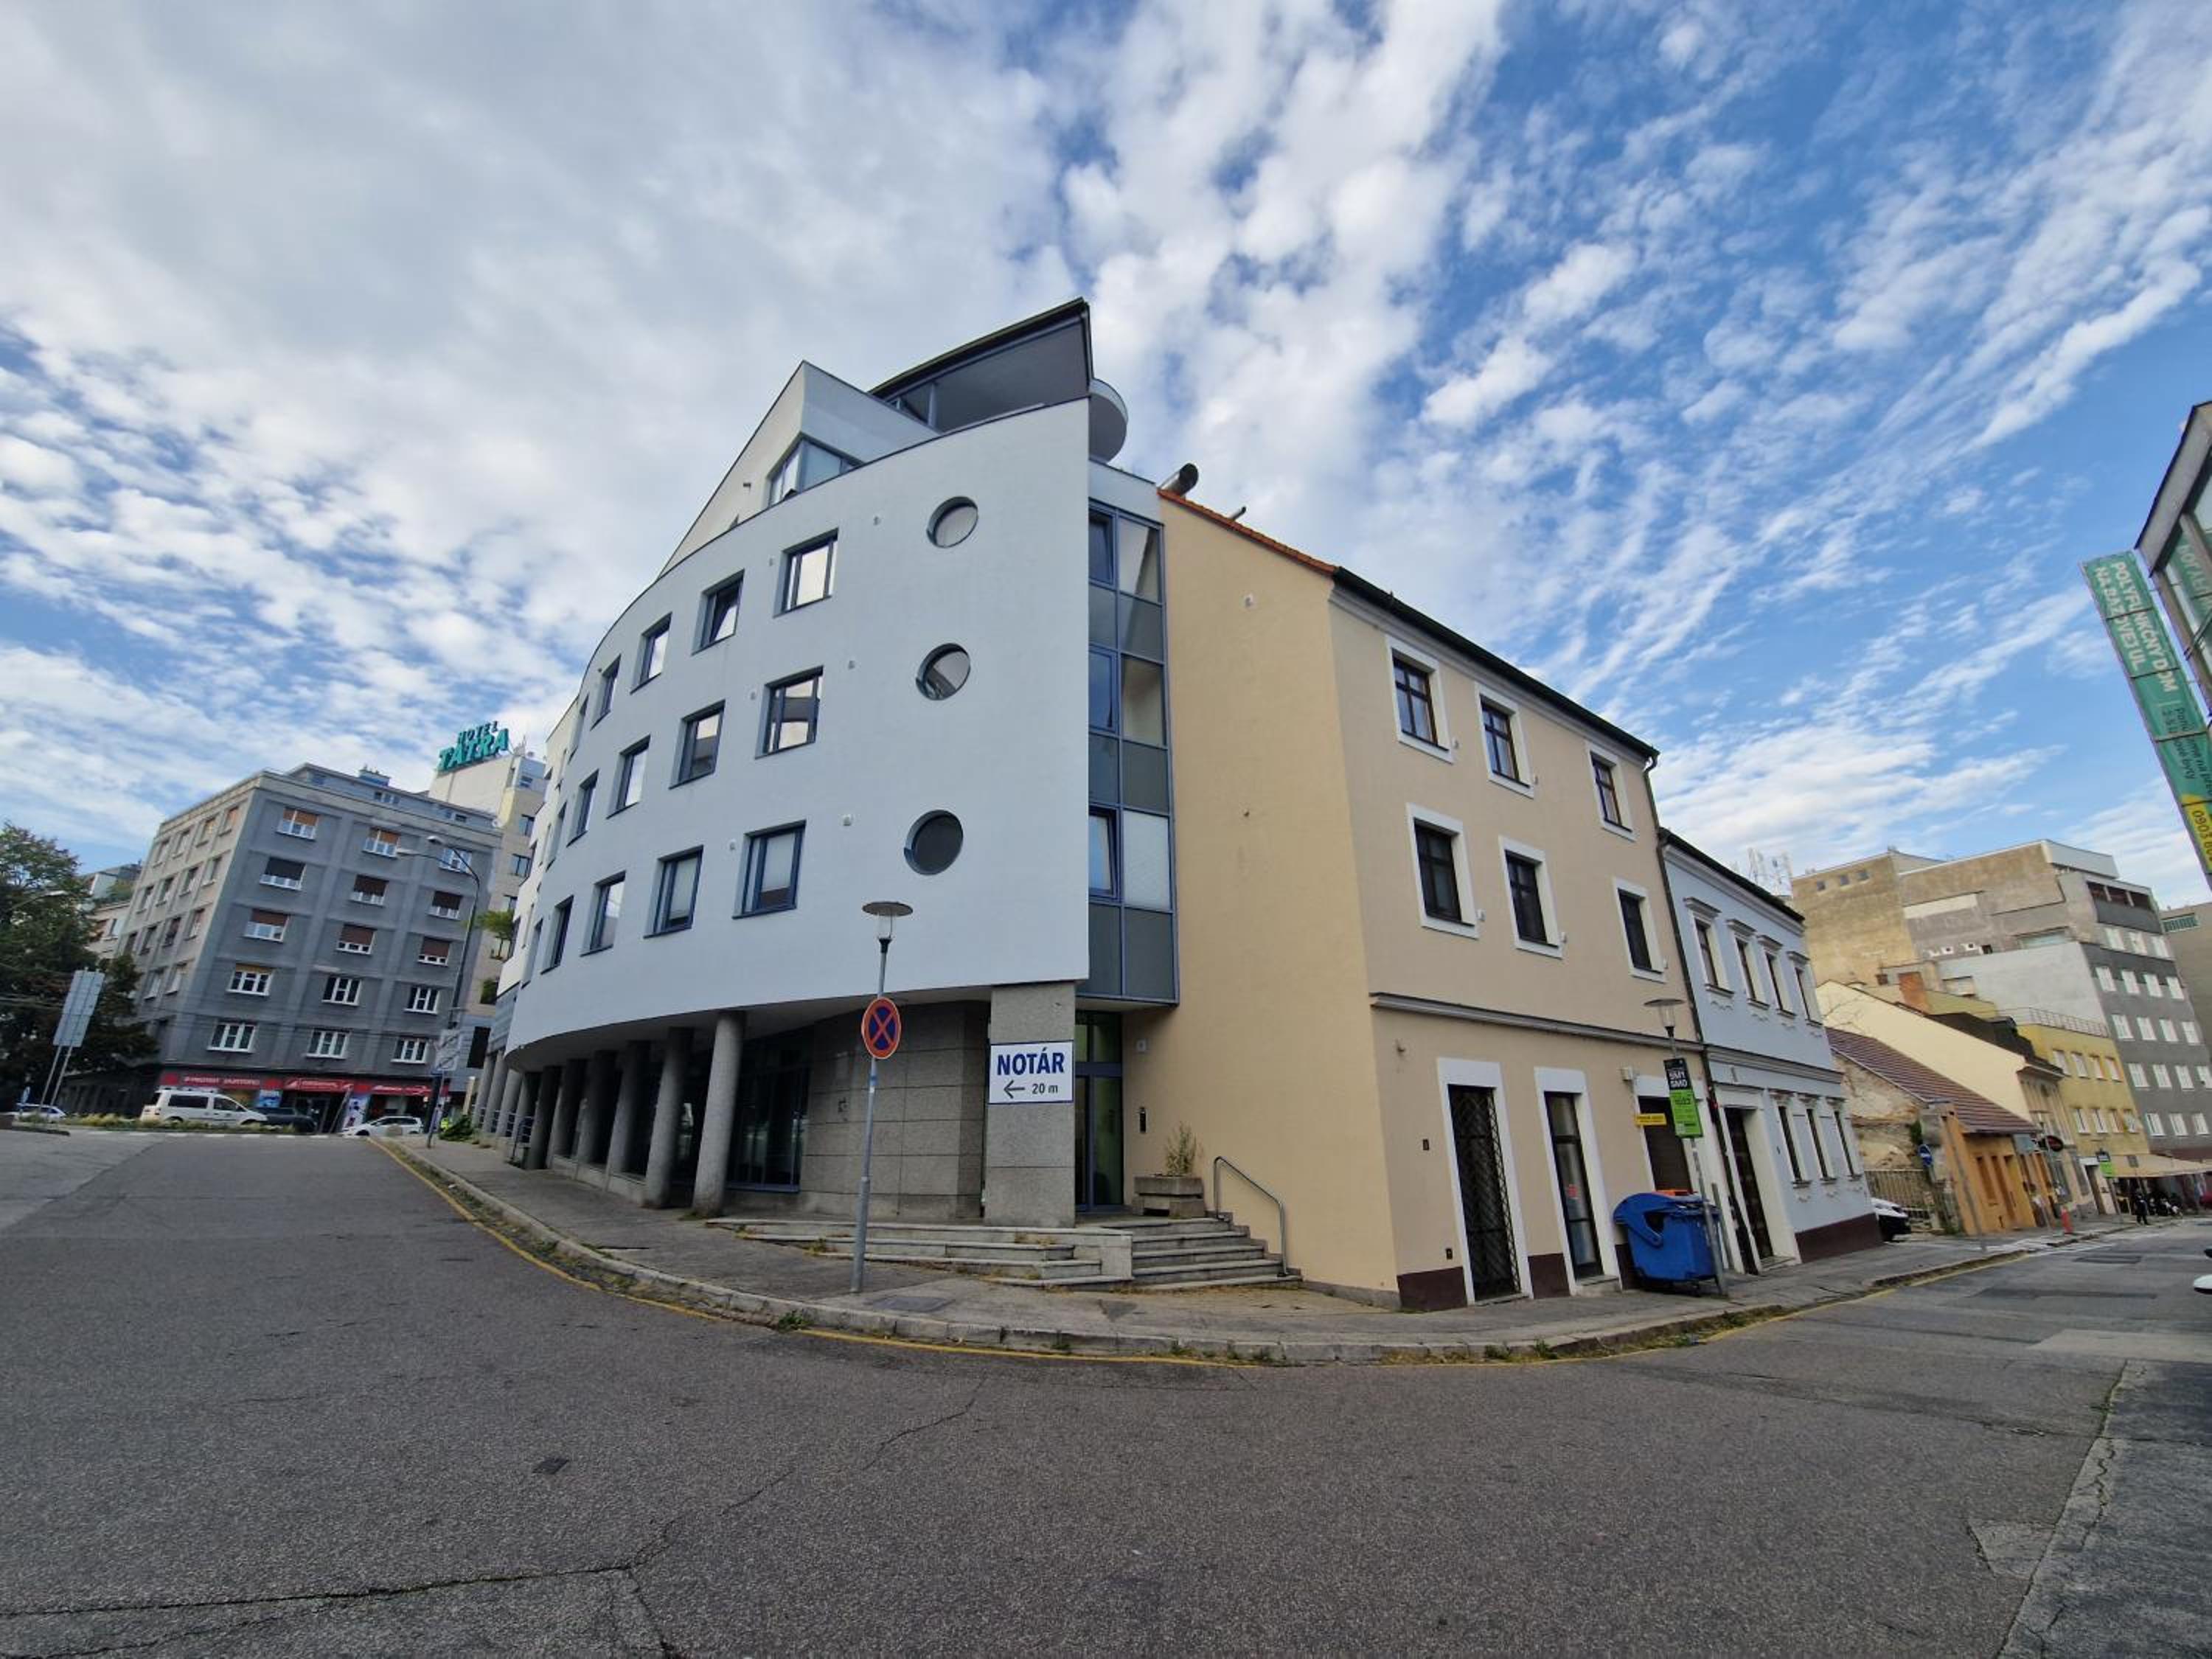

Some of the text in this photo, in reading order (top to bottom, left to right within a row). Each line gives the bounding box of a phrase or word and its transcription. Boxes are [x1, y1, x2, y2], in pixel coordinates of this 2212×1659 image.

[2152, 658, 2180, 692] DOM
[457, 720, 499, 744] HOTEL
[437, 728, 509, 770] TATRA
[997, 1047, 1065, 1076] NOTÁR
[1032, 1083, 1058, 1095] 20 m
